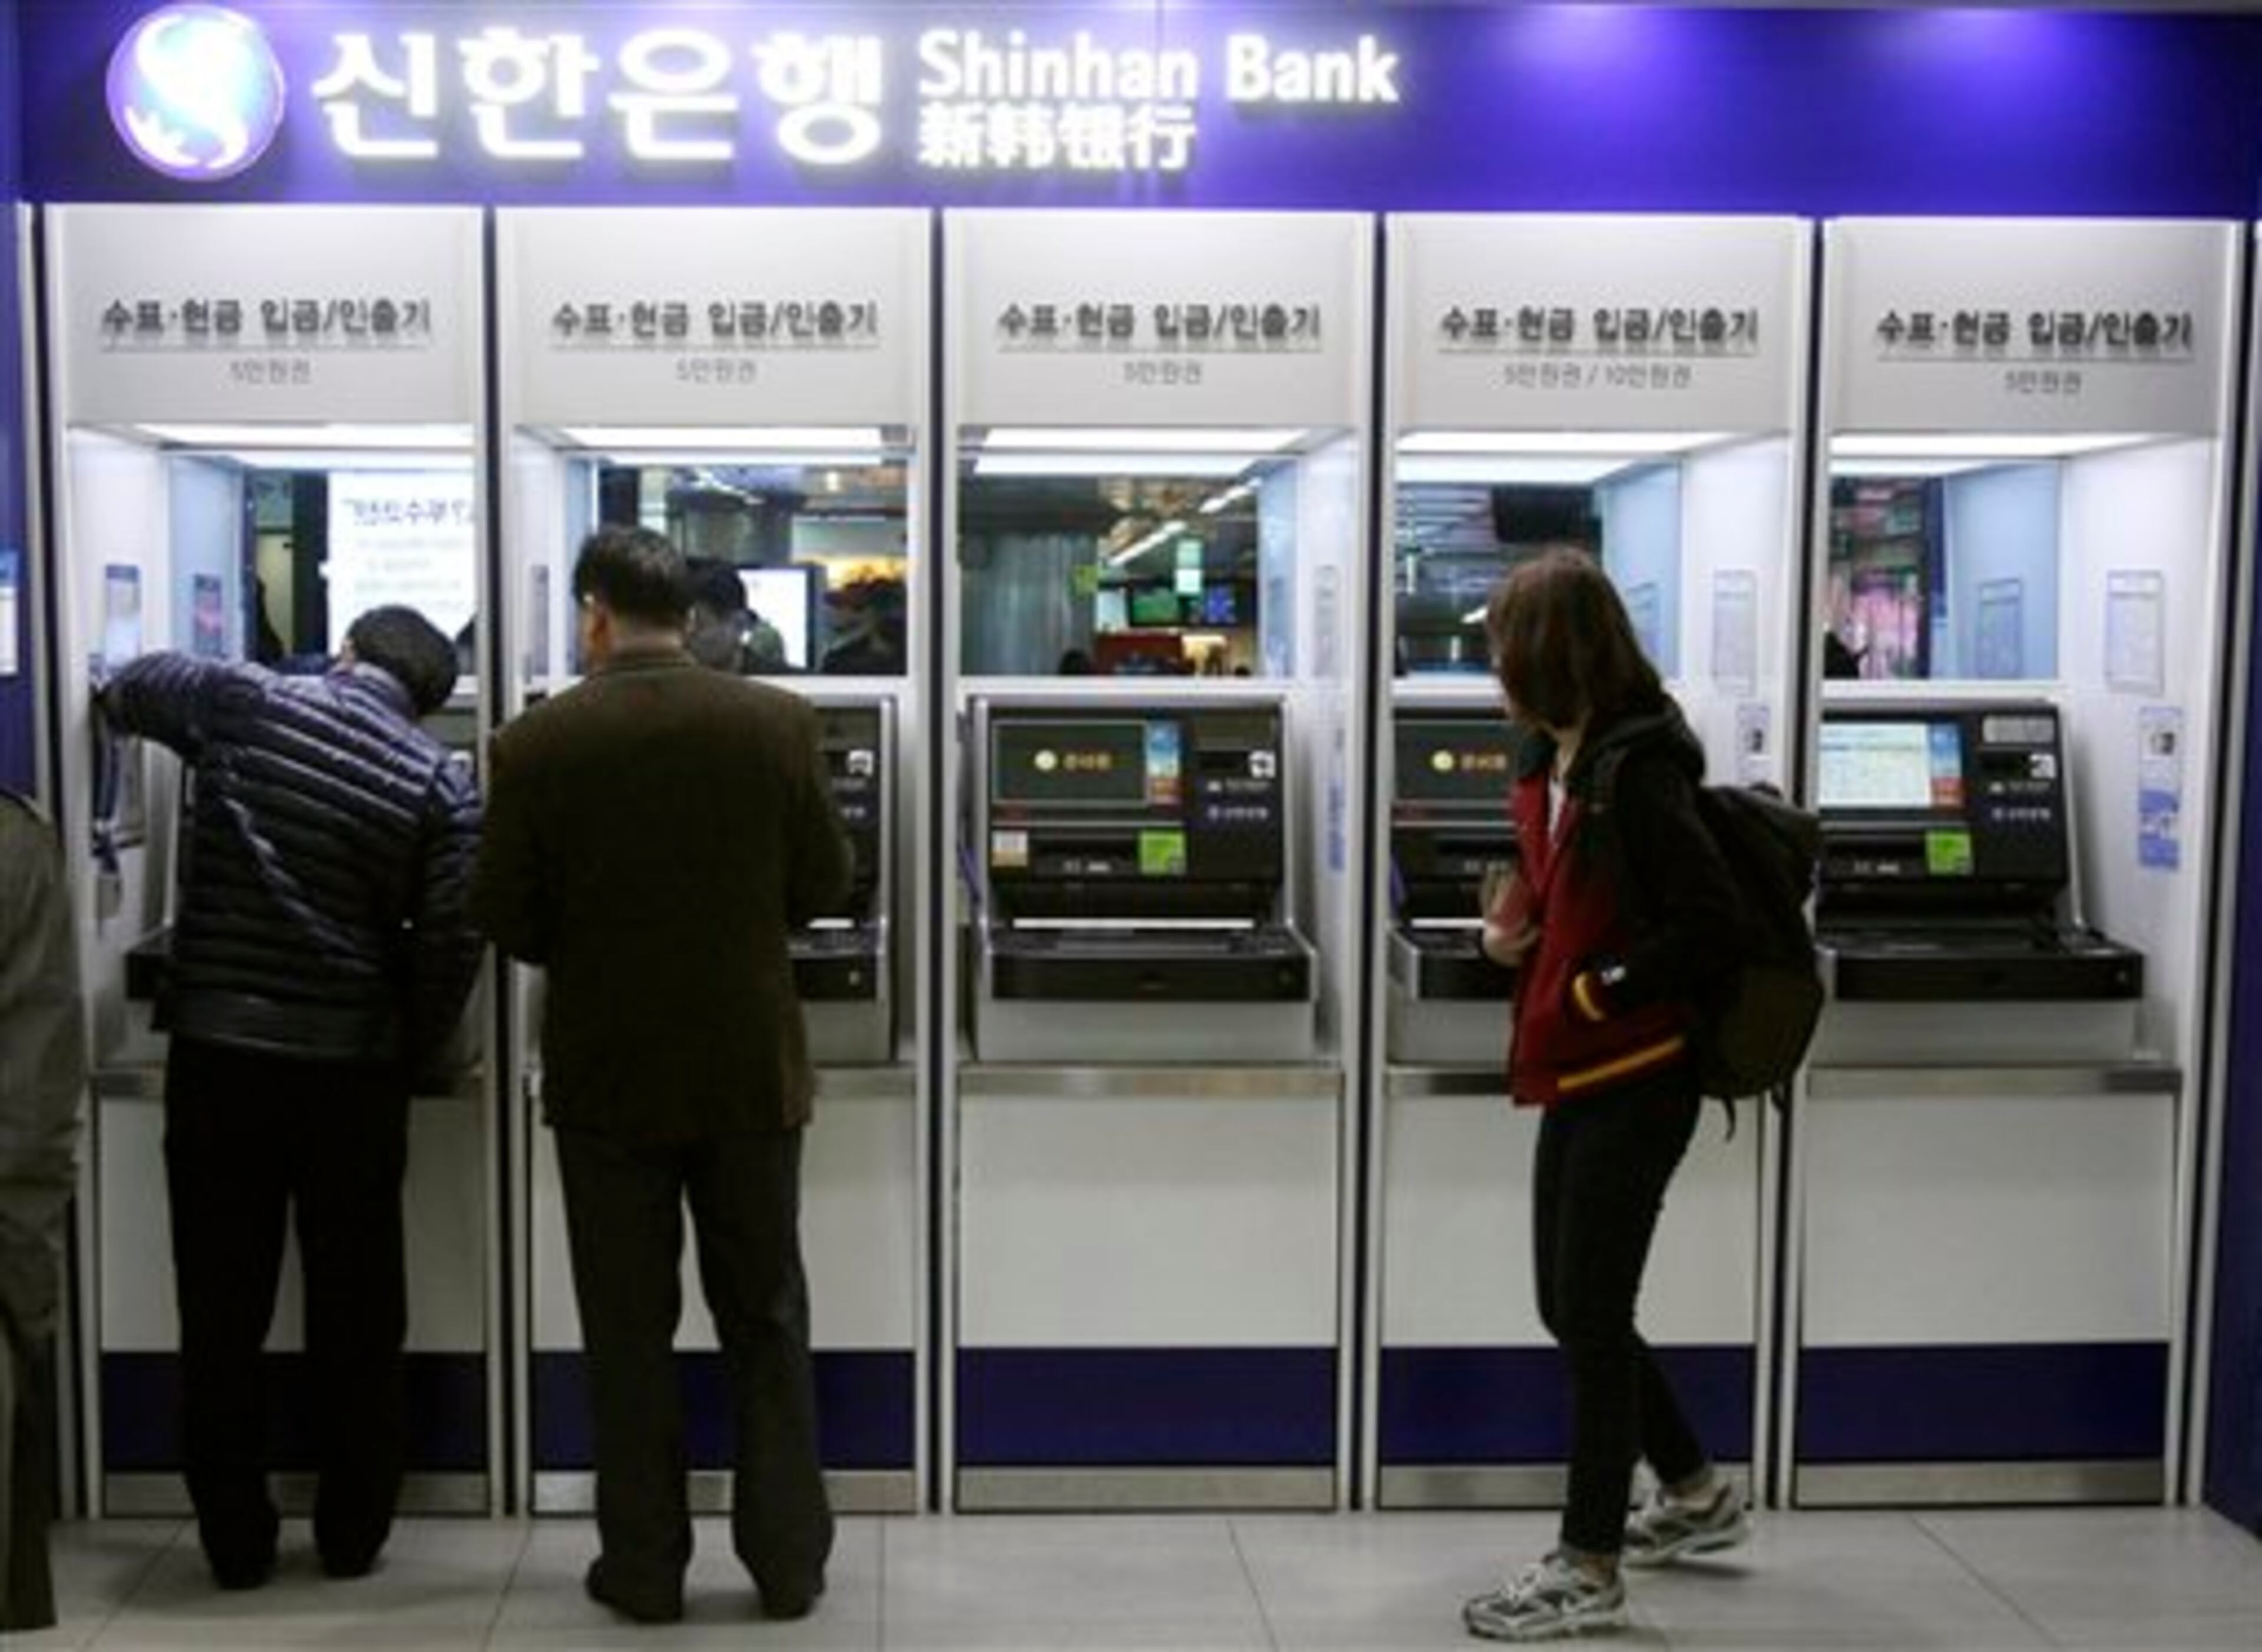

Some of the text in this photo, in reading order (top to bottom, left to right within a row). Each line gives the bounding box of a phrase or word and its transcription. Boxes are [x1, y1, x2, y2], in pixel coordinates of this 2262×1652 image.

[919, 29, 1400, 102] Shinhan Bank
[311, 26, 882, 163] 신한은행
[260, 298, 431, 334] 입금/인출기
[707, 302, 878, 337] 입금/인출기
[1153, 304, 1321, 340] 입금/인출기
[1592, 307, 1760, 343] 입금/인출기
[2028, 311, 2192, 349] 입금/인출기
